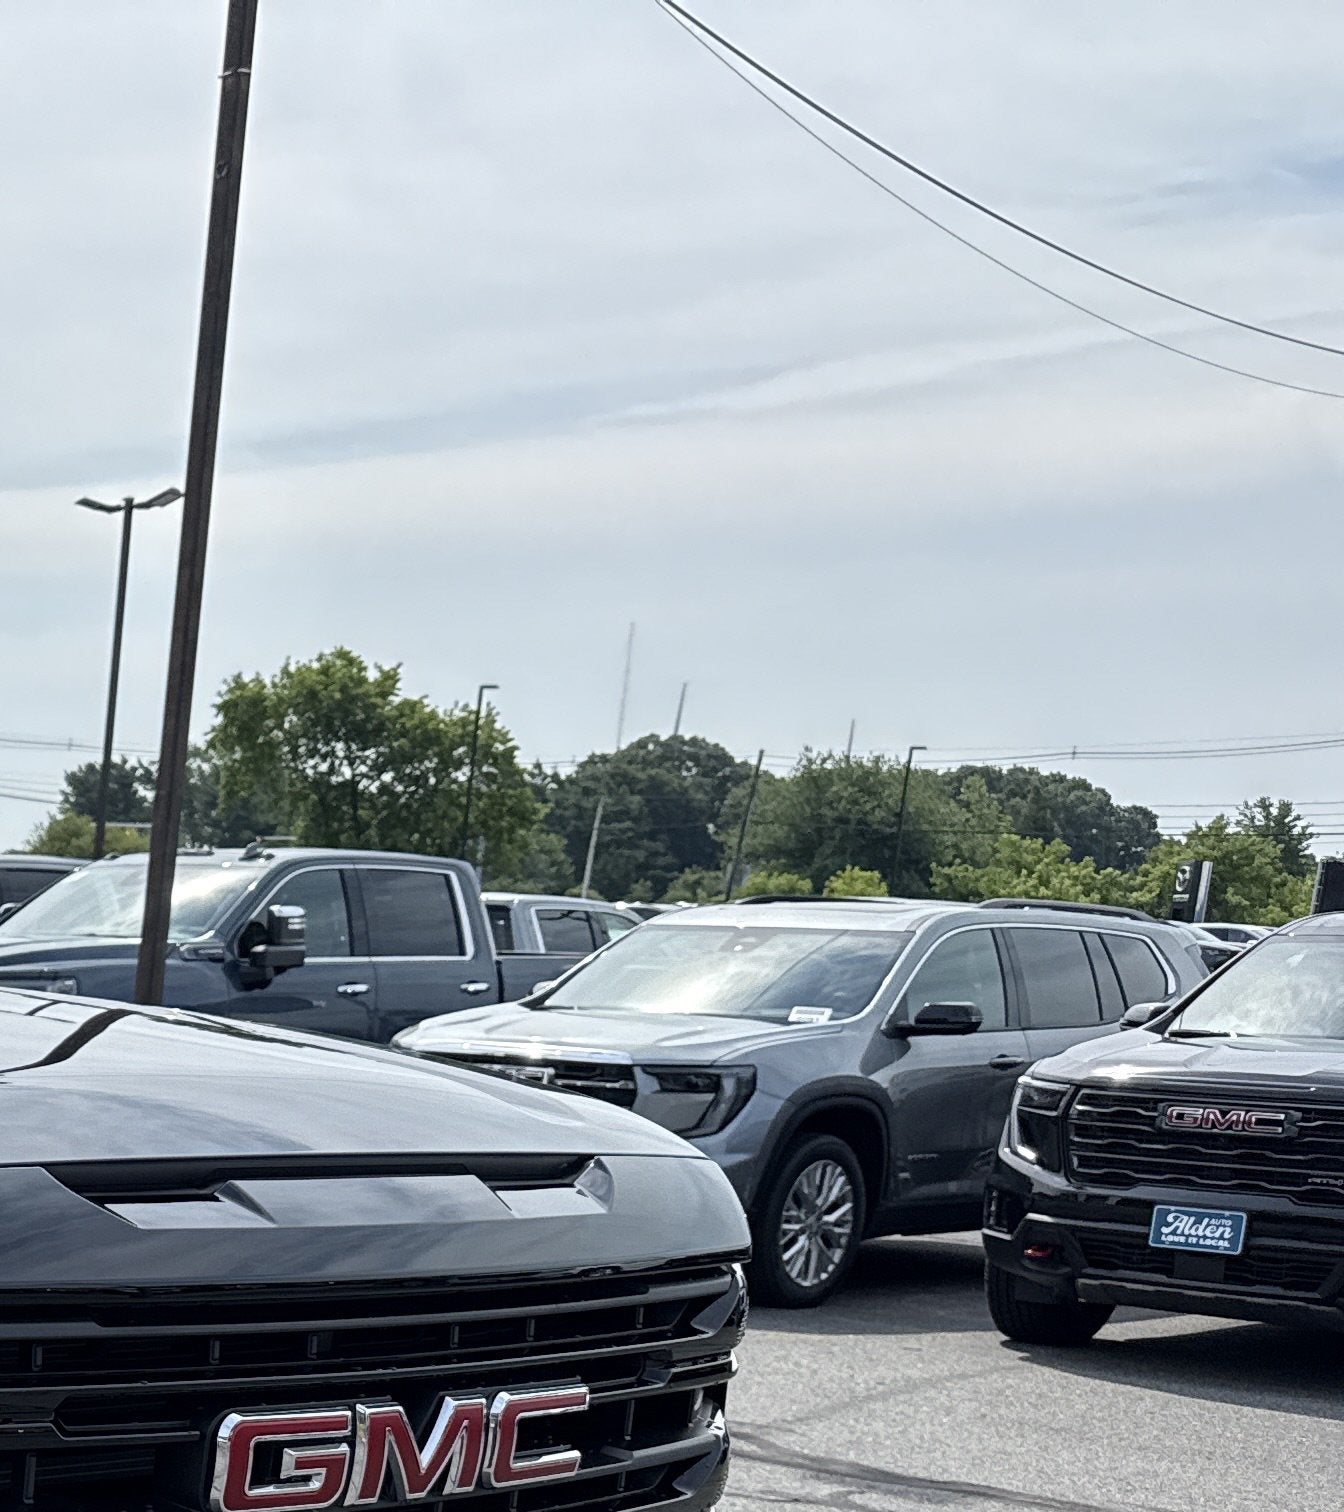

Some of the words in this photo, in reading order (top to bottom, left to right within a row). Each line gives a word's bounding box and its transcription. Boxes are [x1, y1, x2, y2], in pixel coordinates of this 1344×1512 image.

[1166, 1106, 1285, 1134] GMC
[1161, 1212, 1234, 1239] Alden
[1209, 1218, 1232, 1226] AUTO
[1160, 1234, 1186, 1243] LOVE
[1188, 1236, 1199, 1244] IT
[1199, 1238, 1231, 1248] LOCAL
